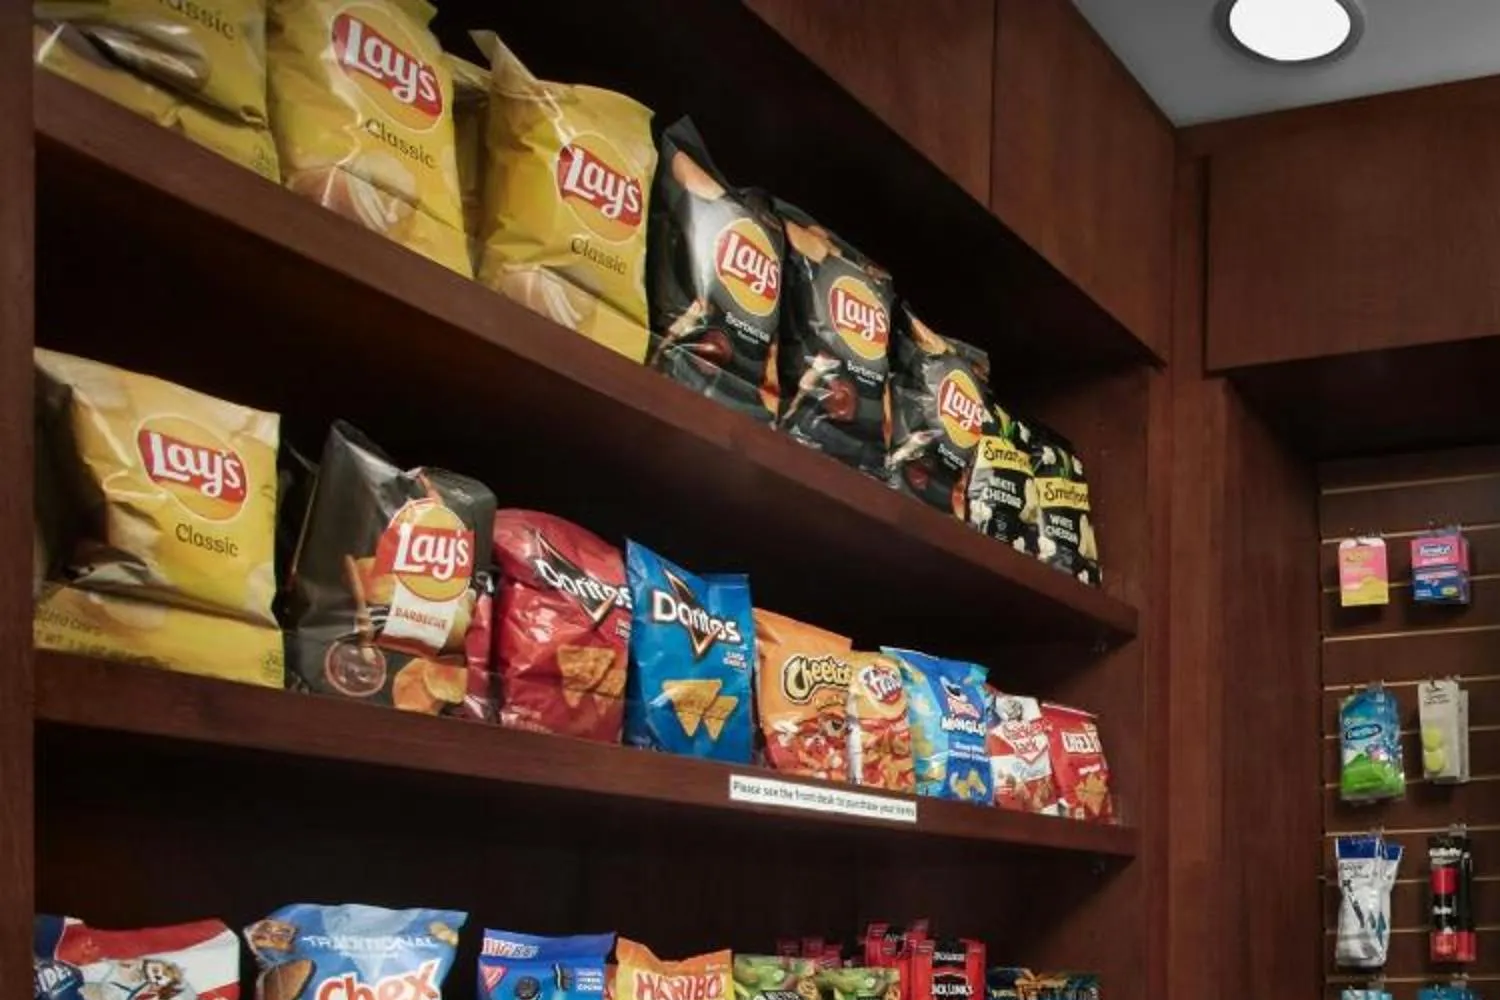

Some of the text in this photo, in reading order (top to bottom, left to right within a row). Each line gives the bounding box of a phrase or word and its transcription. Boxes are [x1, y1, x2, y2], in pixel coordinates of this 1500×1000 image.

[343, 18, 437, 104] Lay's
[365, 117, 437, 169] Classic
[563, 148, 641, 220] Lay's
[570, 236, 628, 277] Classic
[721, 232, 779, 295] Lay's
[836, 289, 888, 341] Lay's
[941, 380, 984, 430] Lay's
[147, 432, 243, 498] Lay's
[175, 522, 240, 559] Classic
[392, 522, 470, 580] Lay's
[532, 557, 632, 611] Doritos
[395, 606, 449, 632] BARBECUE
[652, 589, 742, 642] Doritos
[733, 780, 760, 795] Please
[301, 933, 438, 950] TRADITIONAL
